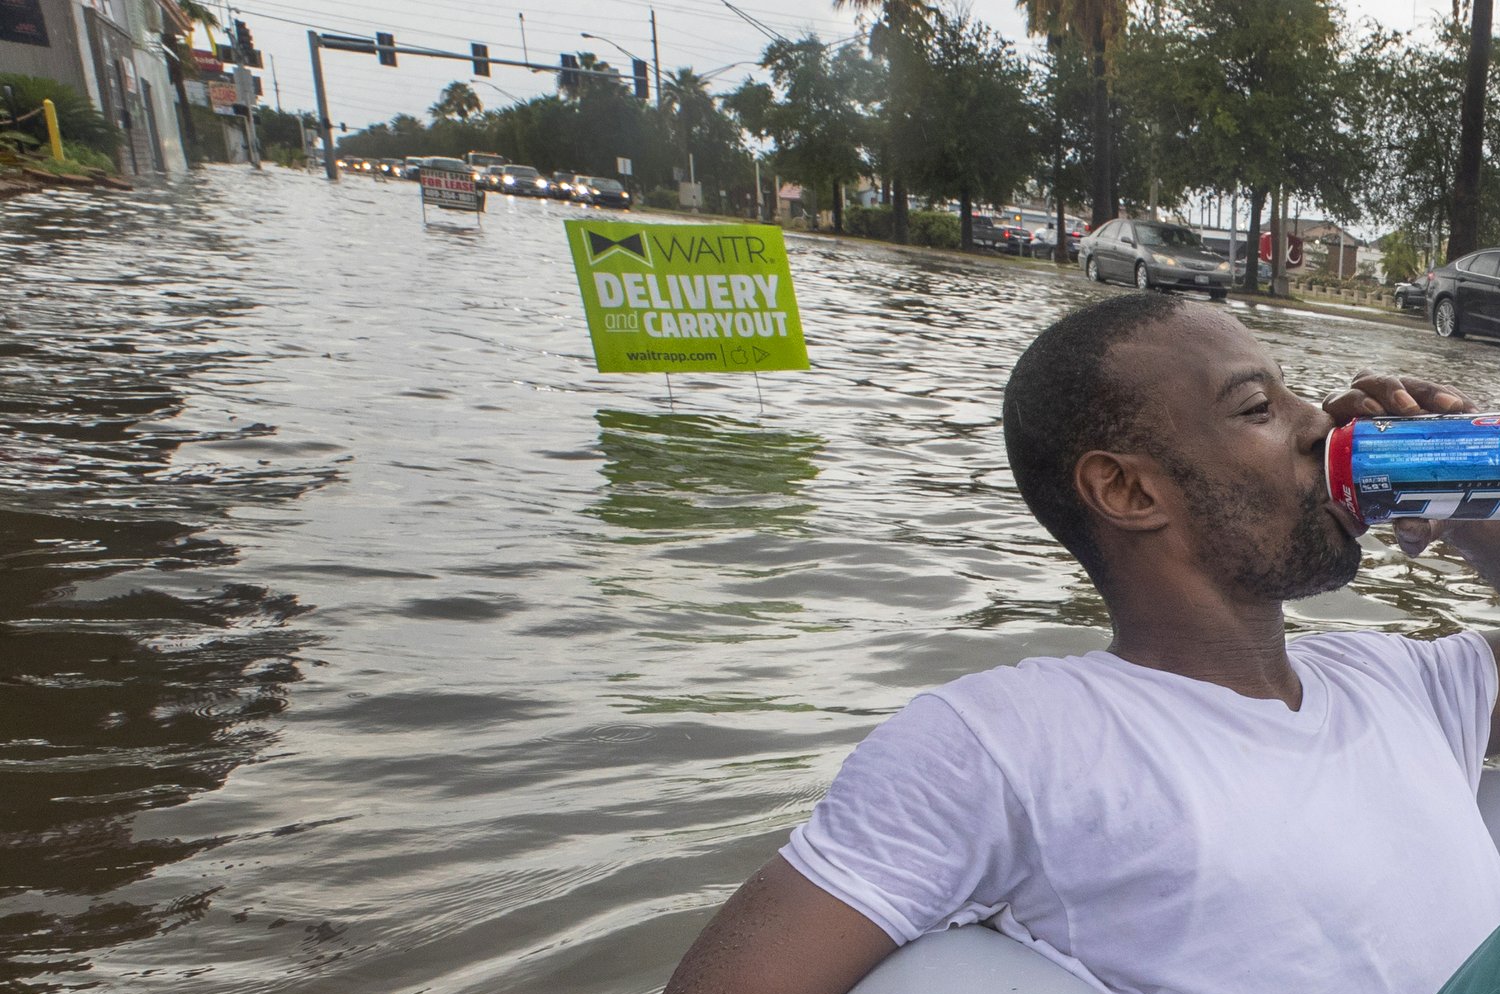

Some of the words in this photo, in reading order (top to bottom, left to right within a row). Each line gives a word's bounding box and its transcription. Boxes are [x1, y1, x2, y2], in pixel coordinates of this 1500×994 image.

[422, 177, 442, 188] FOR
[445, 180, 474, 191] LEASE
[653, 235, 768, 264] WAITR
[593, 272, 778, 310] DELIVERY
[605, 311, 640, 330] and
[643, 311, 788, 339] CARRYOUT
[626, 350, 717, 363] waitrapp.com
